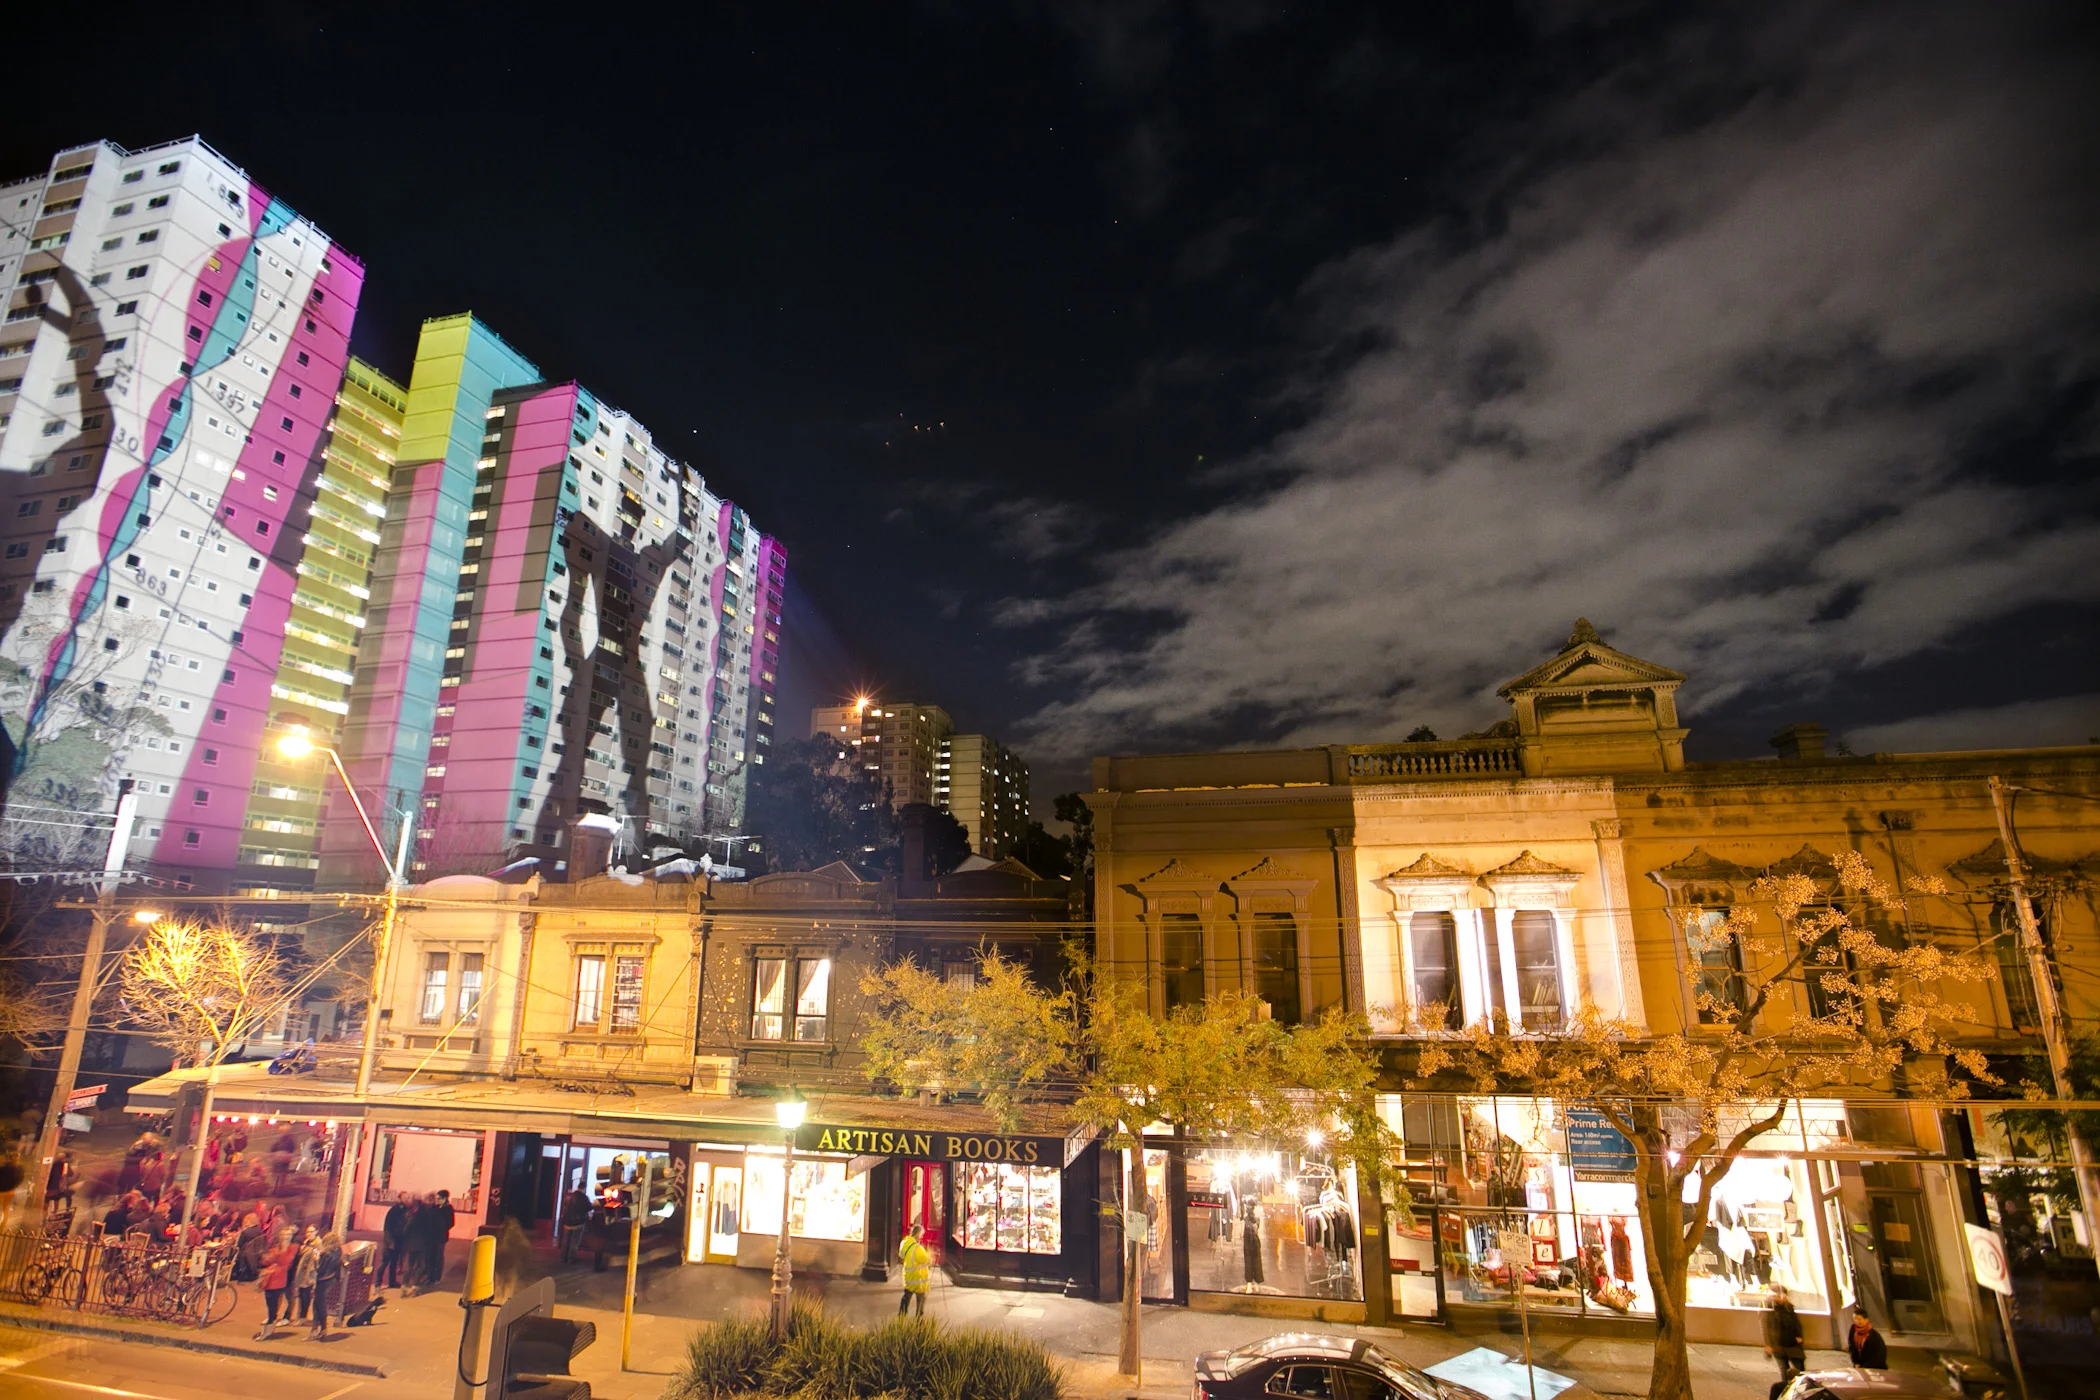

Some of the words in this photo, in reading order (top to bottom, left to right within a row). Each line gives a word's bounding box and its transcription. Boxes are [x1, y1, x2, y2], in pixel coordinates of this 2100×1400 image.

[135, 567, 167, 597] 863
[1569, 1117, 1597, 1129] Prime
[818, 1128, 933, 1156] ARTISAN
[946, 1136, 1038, 1163] BOOKS
[1575, 1171, 1635, 1183] Yarracommercia
[1978, 1247, 2000, 1271] 40
